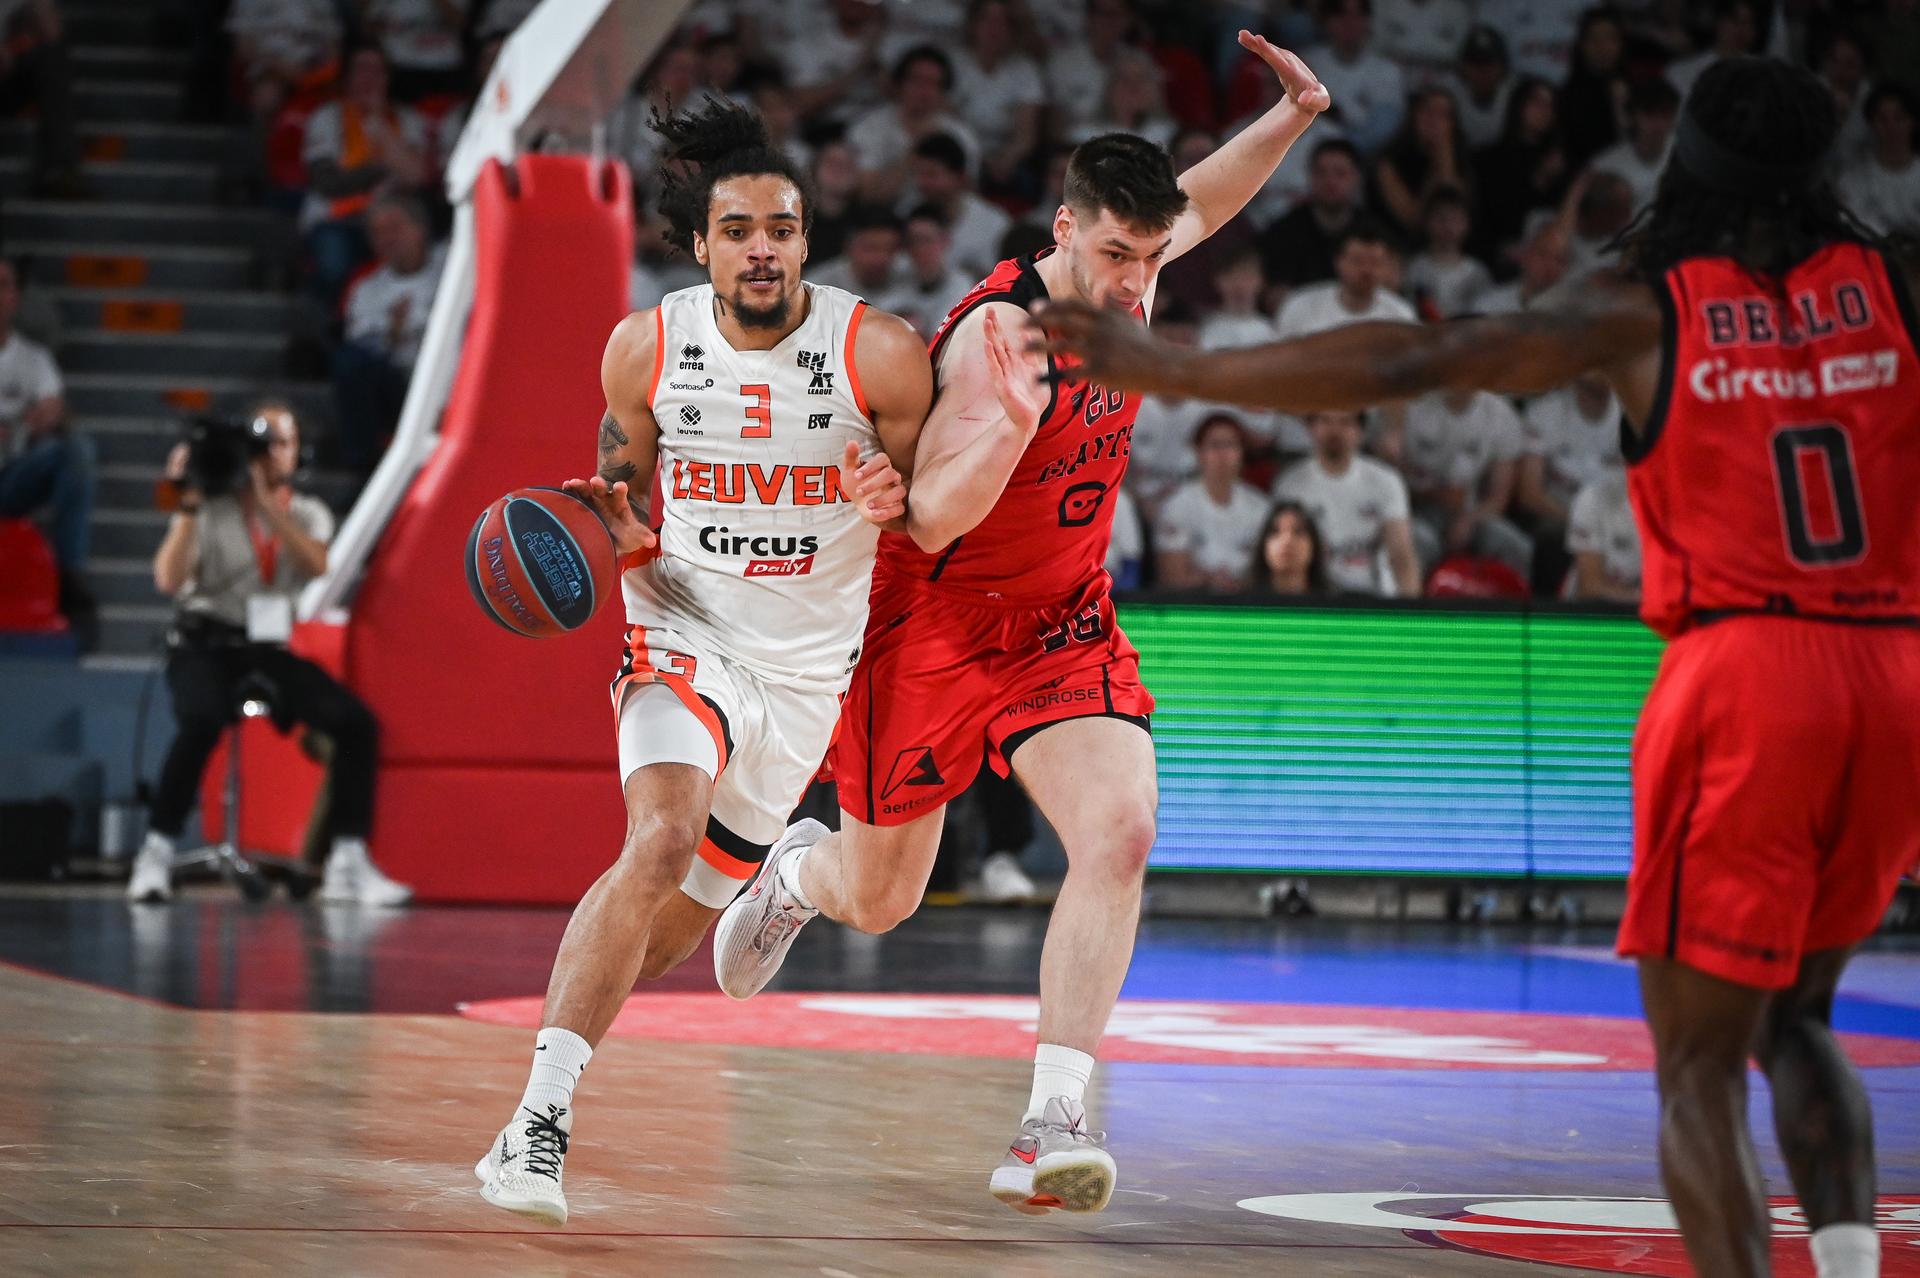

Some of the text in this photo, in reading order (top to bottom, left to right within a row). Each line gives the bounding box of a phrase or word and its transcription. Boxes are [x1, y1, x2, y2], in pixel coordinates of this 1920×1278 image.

[1704, 279, 1874, 349] BELLO
[808, 388, 833, 396] LEAGUE
[1690, 356, 1816, 403] Circus
[677, 427, 704, 436] leuven
[740, 384, 771, 438] 3
[673, 458, 852, 505] LEUVEN
[1767, 418, 1870, 572] 0
[699, 525, 818, 556] Circus
[521, 530, 575, 611] LEGACY
[752, 557, 807, 576] Daily
[1007, 688, 1100, 718] WINDROSE
